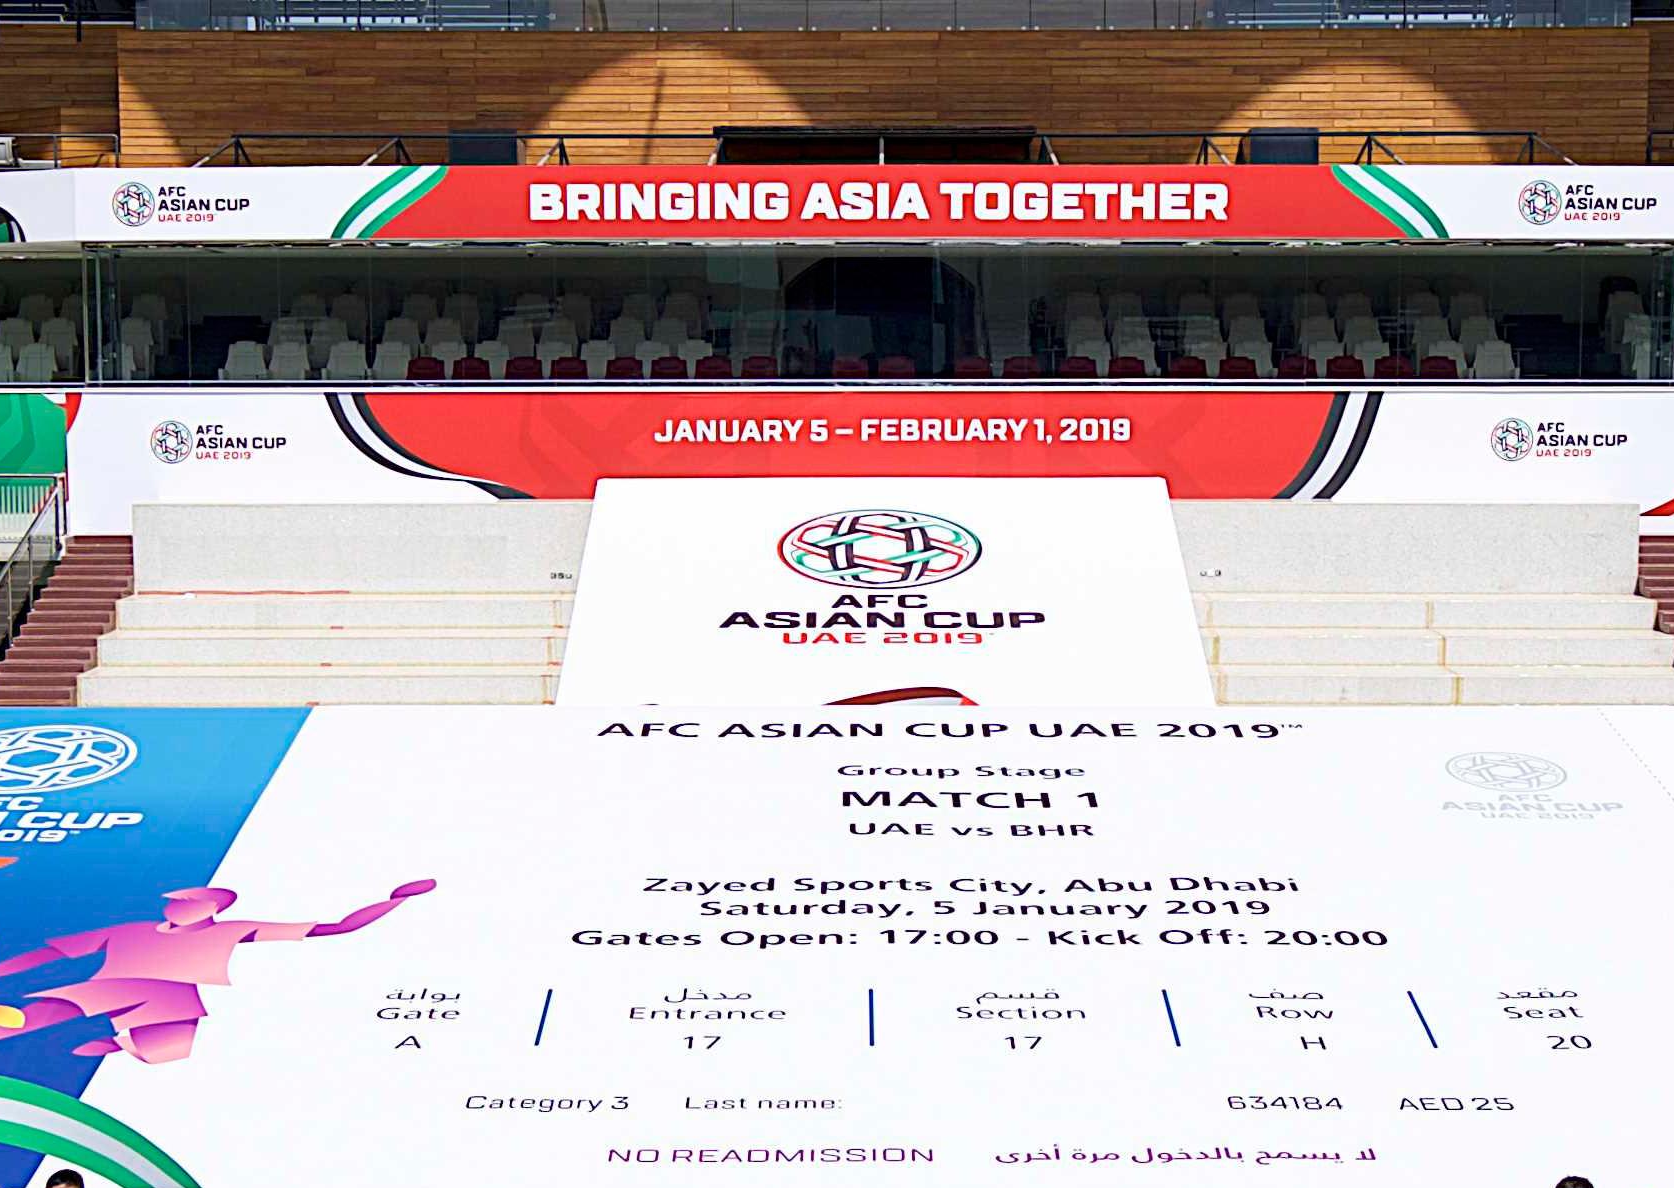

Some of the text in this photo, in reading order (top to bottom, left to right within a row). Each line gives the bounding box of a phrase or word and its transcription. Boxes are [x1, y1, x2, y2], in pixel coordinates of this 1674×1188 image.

[158, 186, 186, 197] AFC
[1565, 185, 1594, 195] AFC
[158, 199, 250, 211] ASIAN CUP
[530, 183, 1227, 220] BRINGING ASIA TOGETHER
[1565, 198, 1657, 210] ASIAN CUP
[158, 214, 182, 222] UAE
[1565, 213, 1587, 221] UAE
[196, 425, 223, 435] AFC
[654, 420, 803, 443] JANUARY
[810, 420, 829, 441] 5
[860, 417, 1028, 442] FEBRUARY
[1034, 419, 1053, 443] 1,
[1060, 417, 1131, 442] 2019
[1537, 423, 1564, 432] AFC
[196, 437, 286, 449] ASIAN CUP
[1537, 435, 1627, 446] ASIAN CUP
[832, 595, 927, 608] AFC
[720, 612, 1045, 628] ASIAN CUP
[783, 633, 865, 644] UAE
[597, 723, 700, 737] AFC
[718, 724, 882, 738] ASIAN
[906, 723, 1008, 737] CUP
[1029, 724, 1136, 737] UAE
[838, 766, 1084, 779] Group Stage
[843, 792, 1098, 808] MATCH 1
[1442, 801, 1624, 812] ASIAN CUP
[16, 812, 143, 829] CUP
[850, 823, 1093, 836] UAE vs BHR
[643, 877, 1298, 896] Zayed Sports City, Abu Dhabi
[701, 901, 1269, 919] Saturday, 5 January 2019
[572, 931, 701, 945] Gates
[721, 931, 856, 949] Open:
[880, 930, 998, 945] 17:00
[1049, 930, 1140, 945] Kick
[1159, 929, 1247, 944] Off:
[1265, 931, 1387, 945] 20:00
[377, 1008, 459, 1019] Gate
[630, 1008, 785, 1019] Entrance
[957, 1007, 1085, 1019] Section
[1257, 1006, 1333, 1019] Row
[1504, 1007, 1582, 1018] Seat
[395, 1036, 420, 1048] A
[685, 1036, 720, 1049] 17
[1005, 1037, 1041, 1049] 17
[1301, 1037, 1326, 1050] H
[1547, 1036, 1591, 1049] 20
[466, 1096, 628, 1112] Category 3
[686, 1097, 843, 1109] Last name:
[1228, 1096, 1342, 1110] 634184
[1400, 1098, 1514, 1110] AED 25
[609, 1148, 933, 1162] NO READMISSION
[996, 1144, 1376, 1165] لا يسمح بالدخول مرة أخرى
